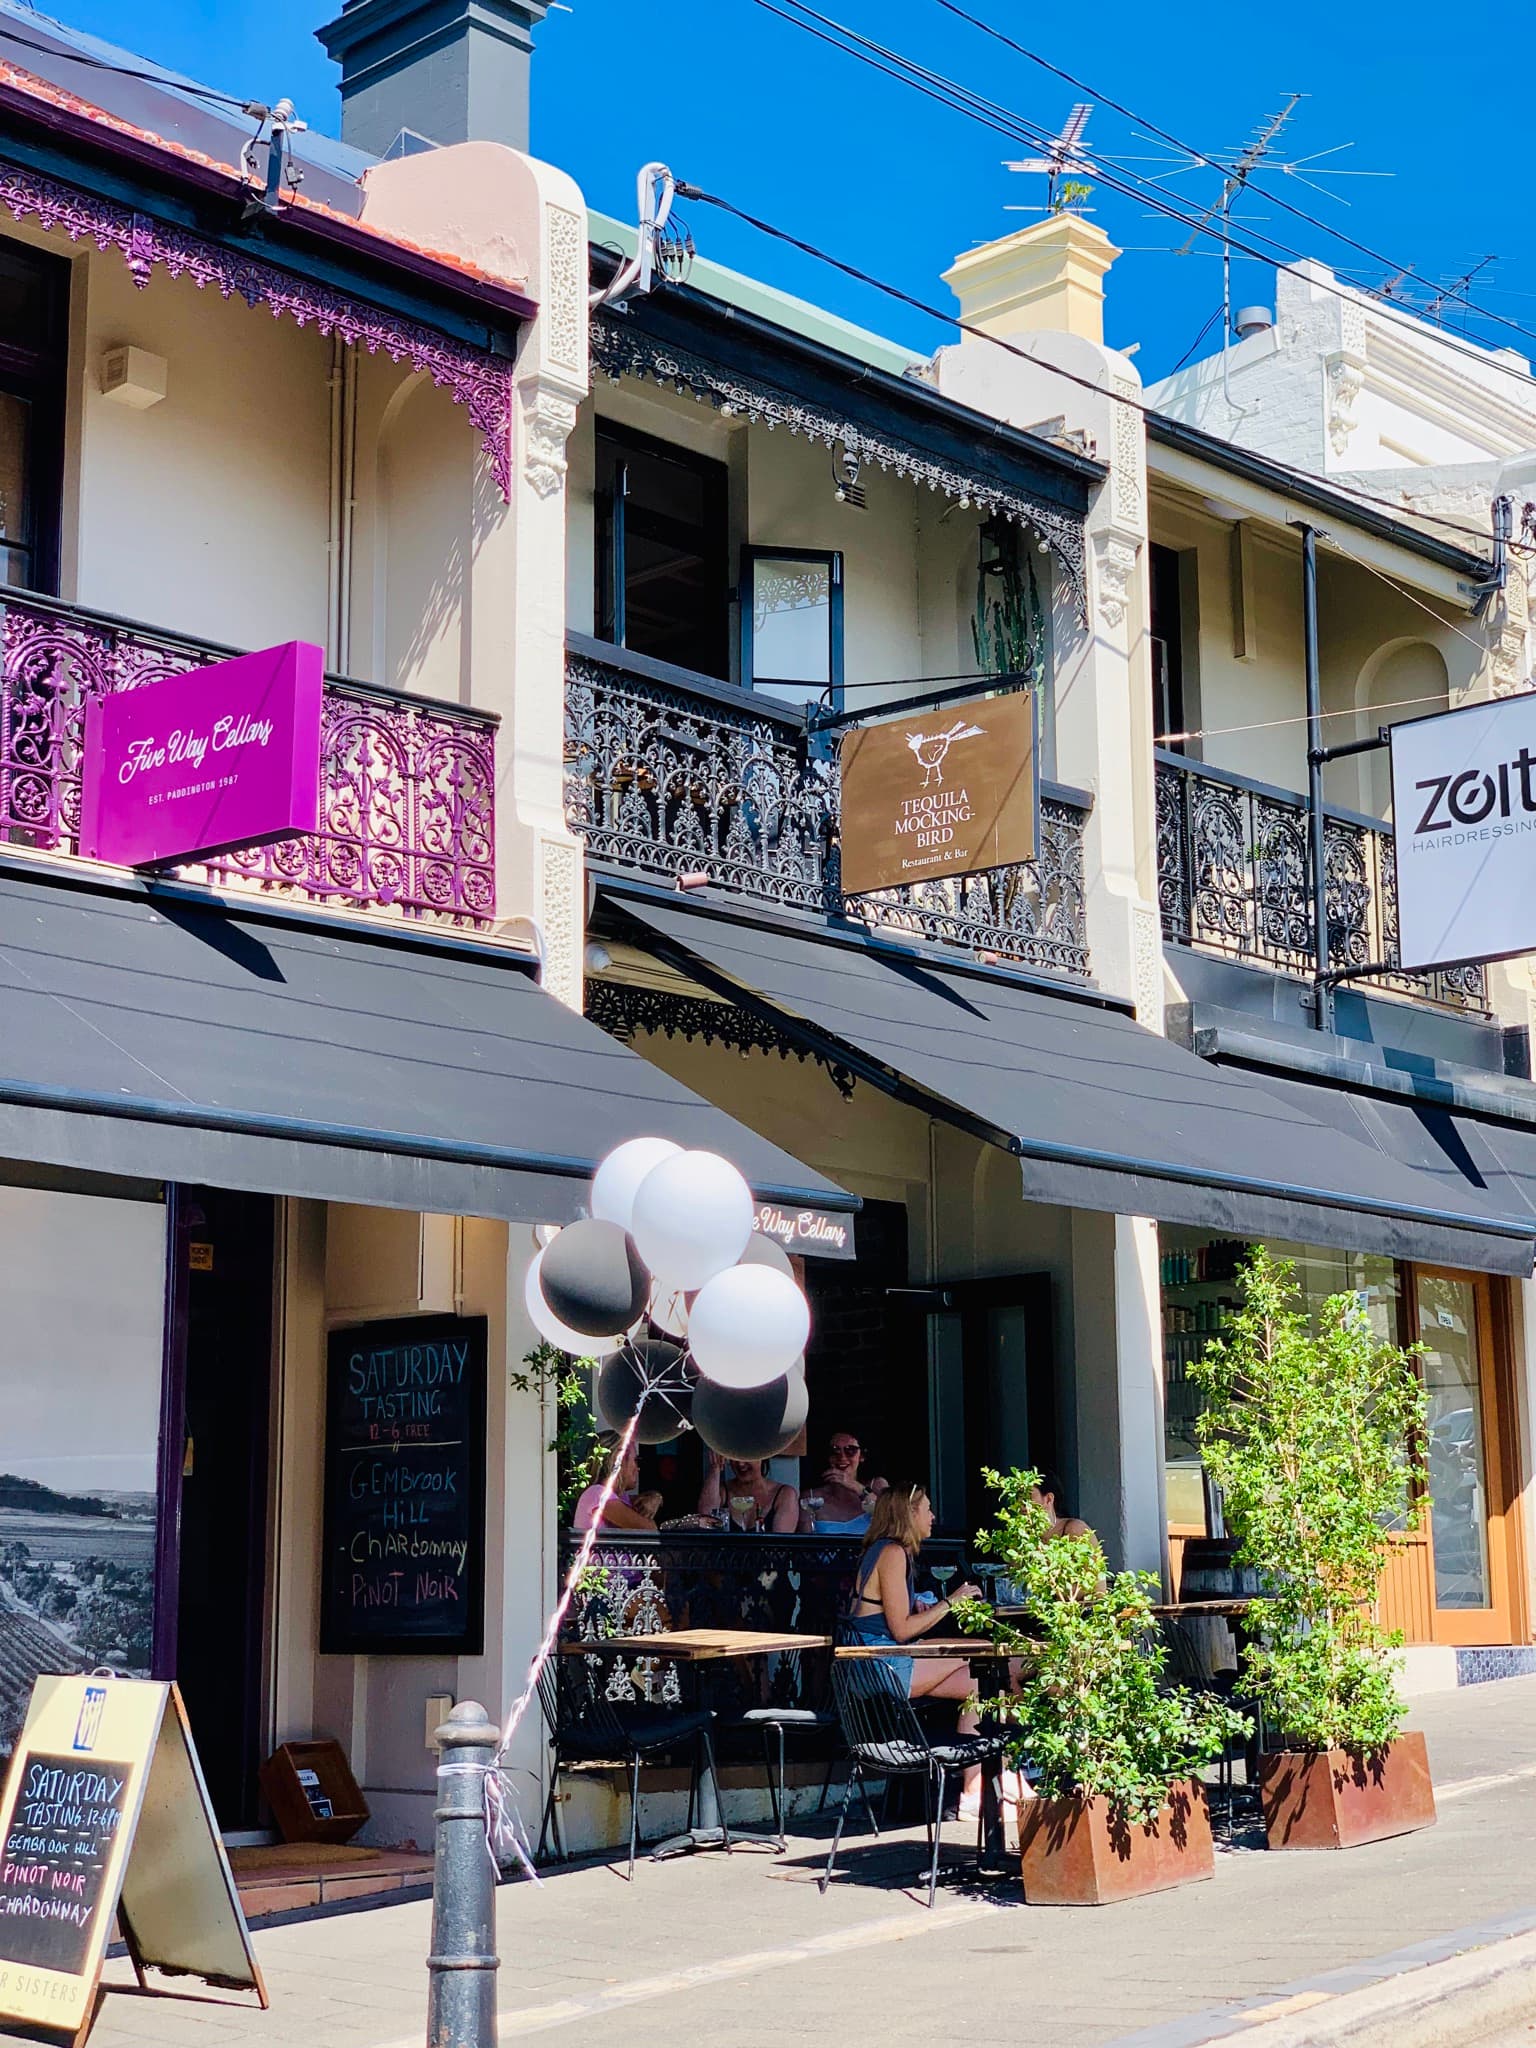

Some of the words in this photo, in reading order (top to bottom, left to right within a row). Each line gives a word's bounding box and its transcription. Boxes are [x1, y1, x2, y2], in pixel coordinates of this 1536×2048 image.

[118, 737, 166, 784] Five
[168, 729, 209, 768] Way
[212, 714, 273, 752] Cellars
[167, 780, 216, 801] PADDINGTON
[219, 775, 239, 788] 1987
[901, 788, 969, 816] TEQUILA
[894, 805, 976, 836] MOCKING-
[916, 827, 954, 848] BIRD
[901, 854, 943, 869] Restaurant
[943, 851, 953, 861] &
[954, 848, 969, 859] Bar
[760, 1206, 796, 1244] Way
[797, 1211, 846, 1248] Cellars
[350, 1342, 468, 1395] SATURDAY
[359, 1389, 441, 1420] TASTING
[405, 1423, 431, 1438] FREE
[25, 1764, 123, 1806] SATURDAY
[74, 1842, 97, 1856] HILL
[3, 1862, 49, 1885] PINOT
[52, 1870, 86, 1896] NOIR
[16, 1975, 78, 2002] SISTERS
